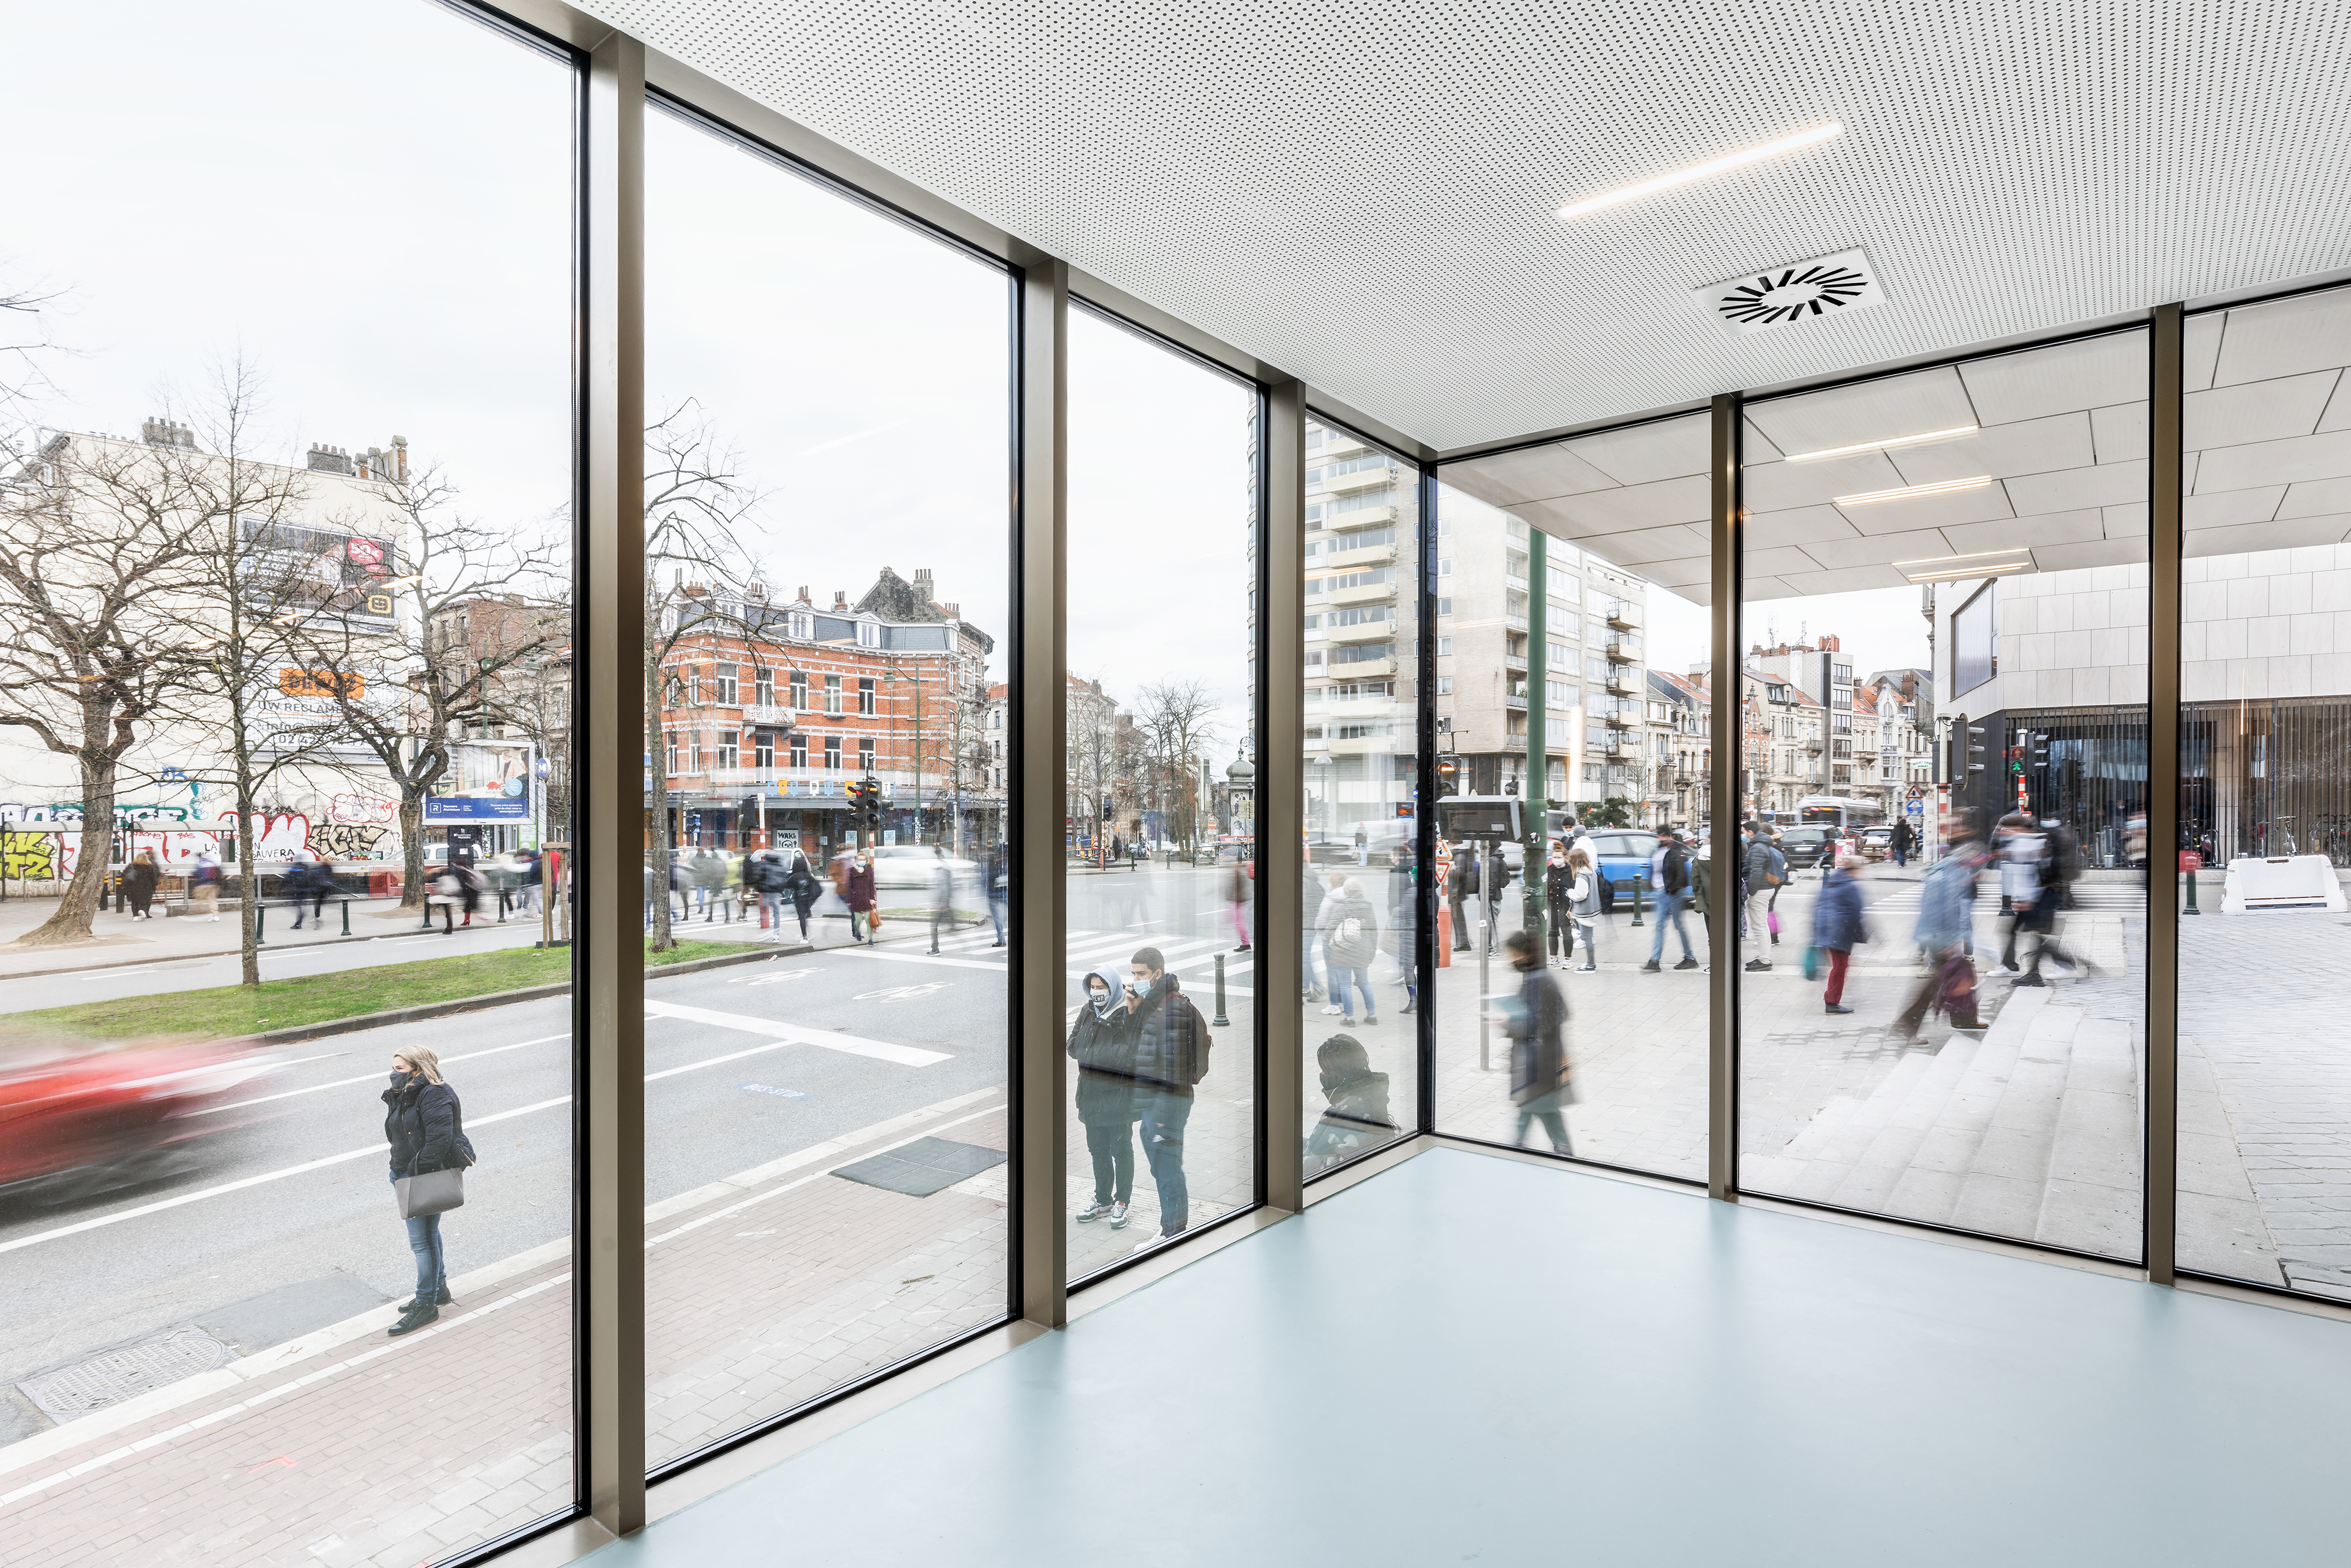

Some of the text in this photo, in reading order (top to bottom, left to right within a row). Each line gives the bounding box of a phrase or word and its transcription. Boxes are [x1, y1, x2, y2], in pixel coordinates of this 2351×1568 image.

[538, 764, 546, 772] M
[205, 843, 218, 851] LA
[742, 1083, 805, 1098] BUS-STOP
